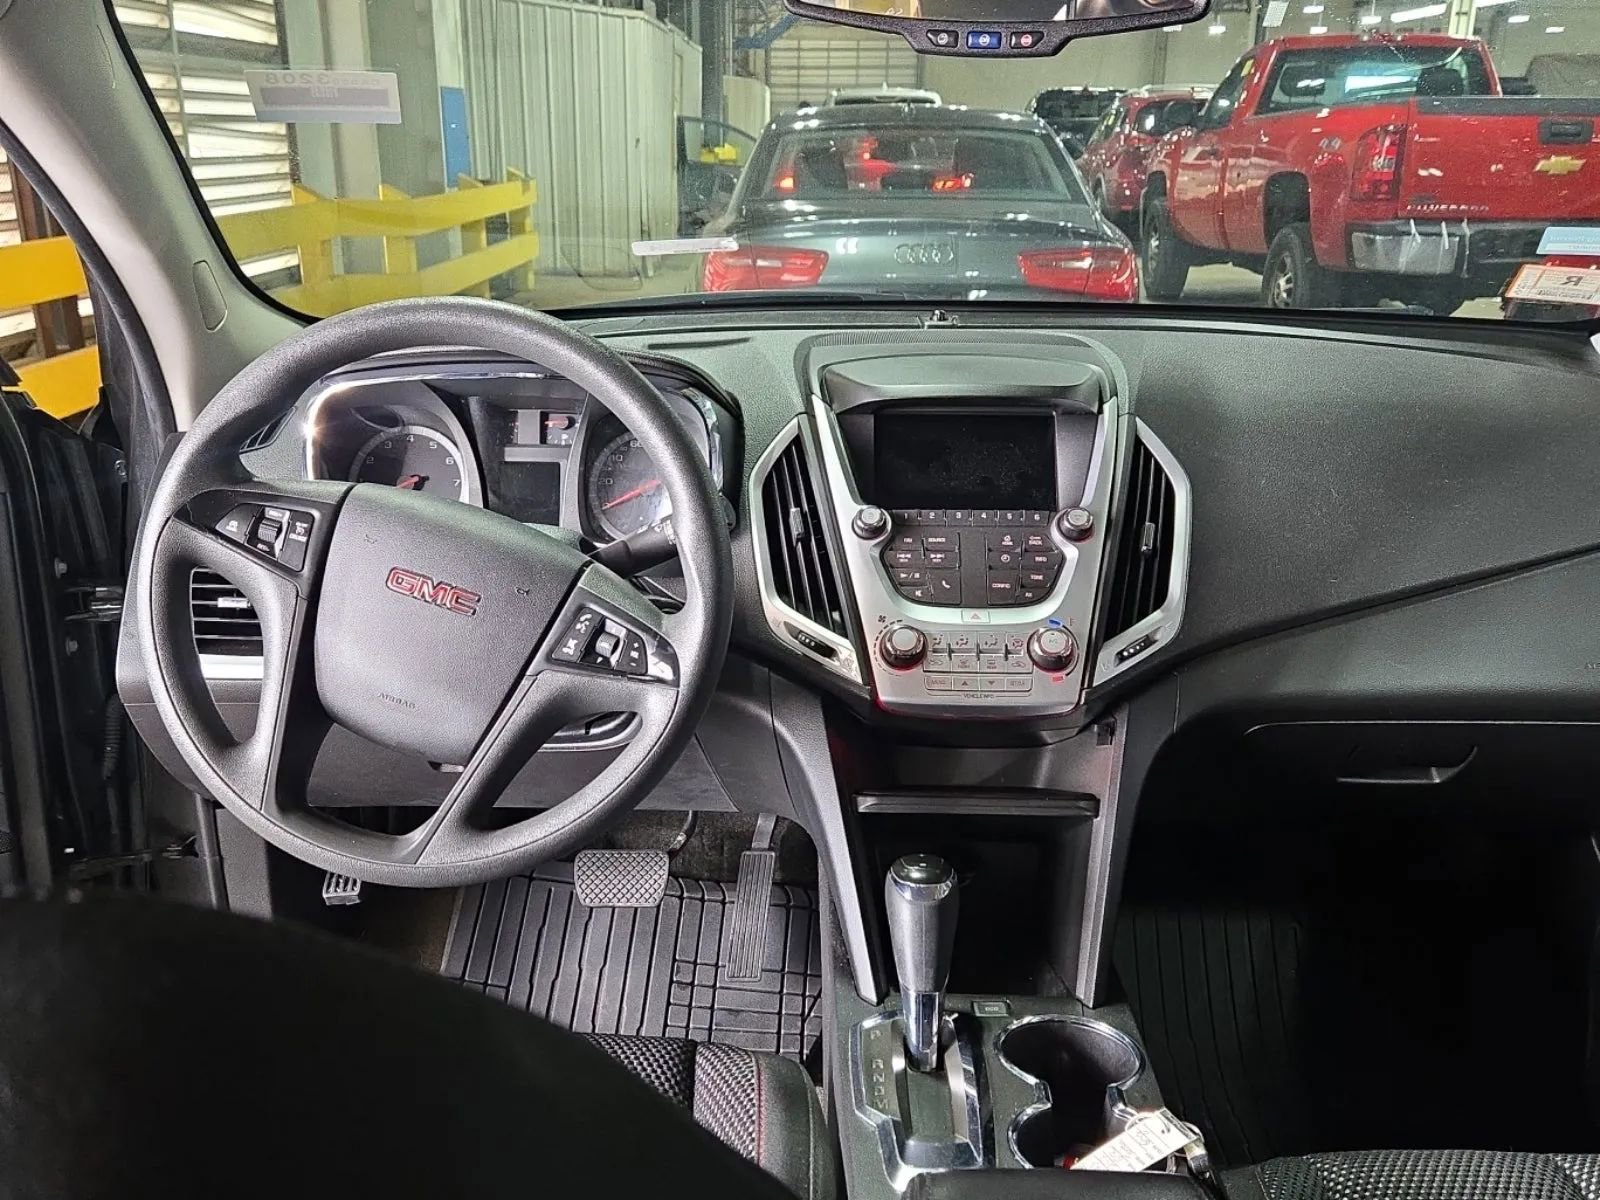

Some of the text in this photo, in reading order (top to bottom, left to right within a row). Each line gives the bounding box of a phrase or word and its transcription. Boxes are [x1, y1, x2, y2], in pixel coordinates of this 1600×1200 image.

[406, 434, 414, 443] 4
[384, 441, 392, 449] 3
[429, 441, 438, 449] 5
[445, 456, 455, 465] 6
[453, 479, 461, 487] 7
[904, 512, 908, 520] 1
[1034, 513, 1041, 521] 6
[385, 566, 482, 616] GMC
[870, 1029, 882, 1040] P
[872, 1059, 884, 1069] R
[873, 1073, 885, 1083] N
[874, 1086, 885, 1096] D
